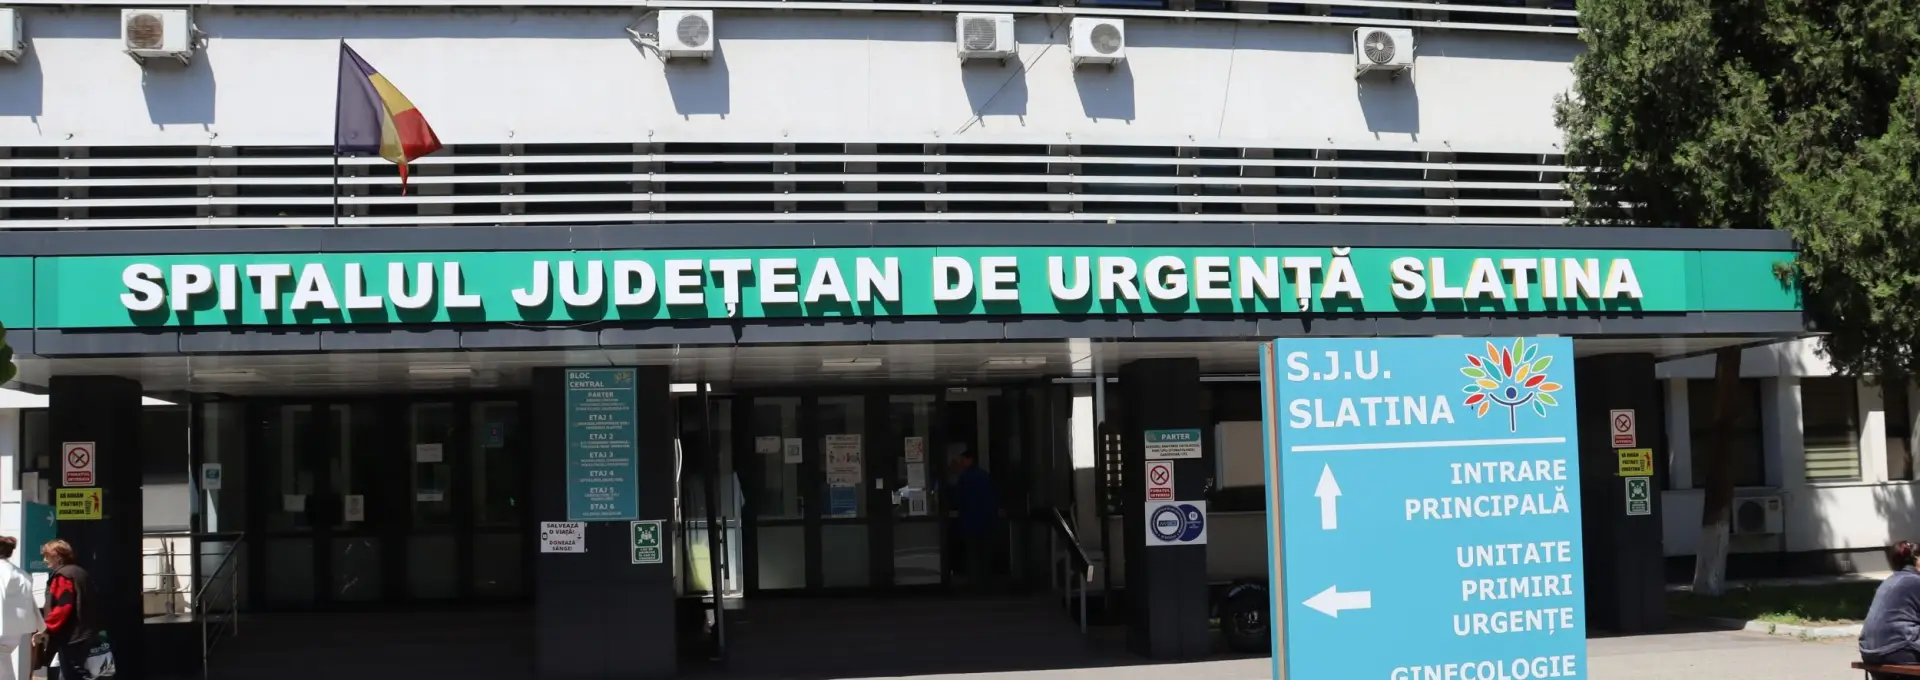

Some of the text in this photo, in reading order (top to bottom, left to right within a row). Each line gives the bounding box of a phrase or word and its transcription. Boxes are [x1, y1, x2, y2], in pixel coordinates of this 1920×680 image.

[120, 246, 1644, 317] SPITALUL JUDEȚEAN DE URGENȚĂ SLATINA
[1286, 350, 1391, 382] S.J.U.
[1289, 395, 1455, 429] SLATINA
[1450, 459, 1567, 485] INTRARE
[1405, 485, 1569, 521] PRINCIPALĂ
[1456, 540, 1571, 568] UNITATE
[1462, 574, 1573, 601] PRIMIRI
[1453, 607, 1574, 636] URGENȚE
[1390, 654, 1576, 680] GINECOLOGIE
